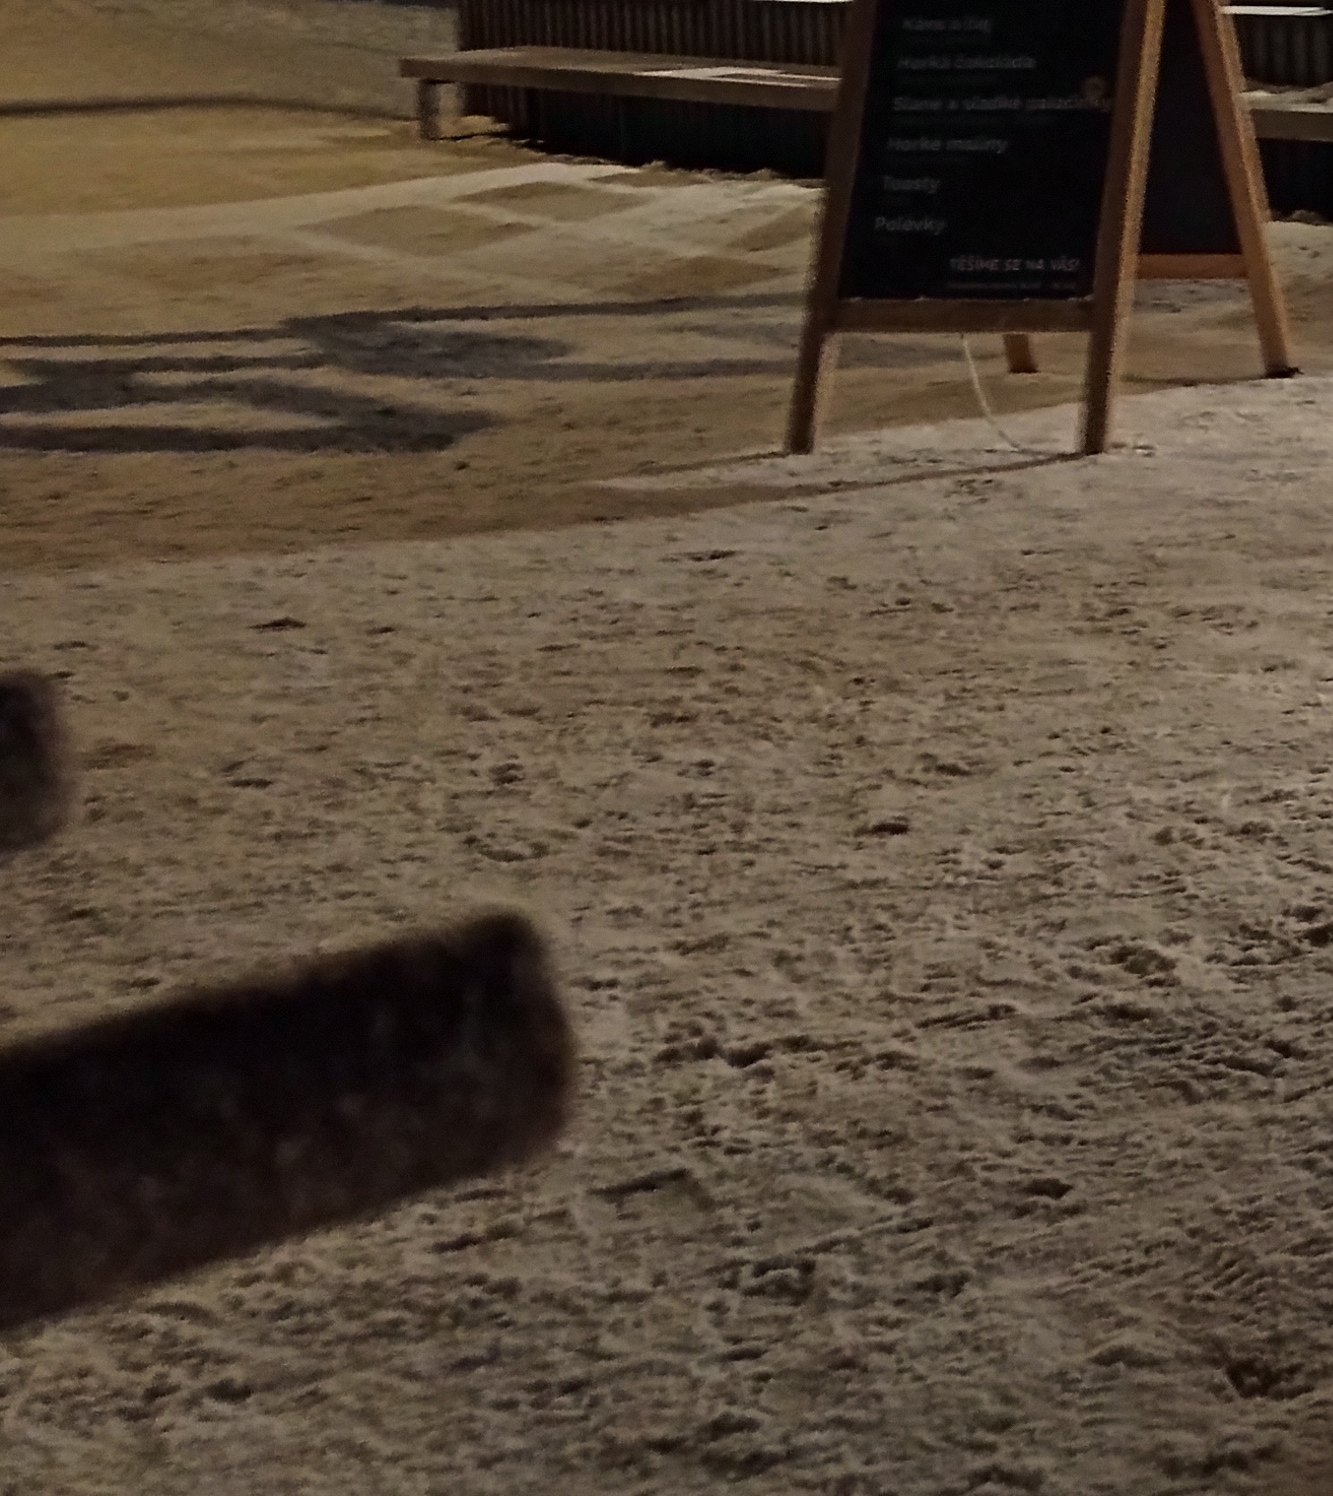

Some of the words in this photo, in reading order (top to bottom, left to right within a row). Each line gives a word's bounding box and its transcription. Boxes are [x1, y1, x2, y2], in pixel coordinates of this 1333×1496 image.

[881, 175, 943, 195] Toasty
[873, 214, 948, 237] Polévky
[1002, 258, 1023, 272] SE
[1025, 258, 1045, 271] NA
